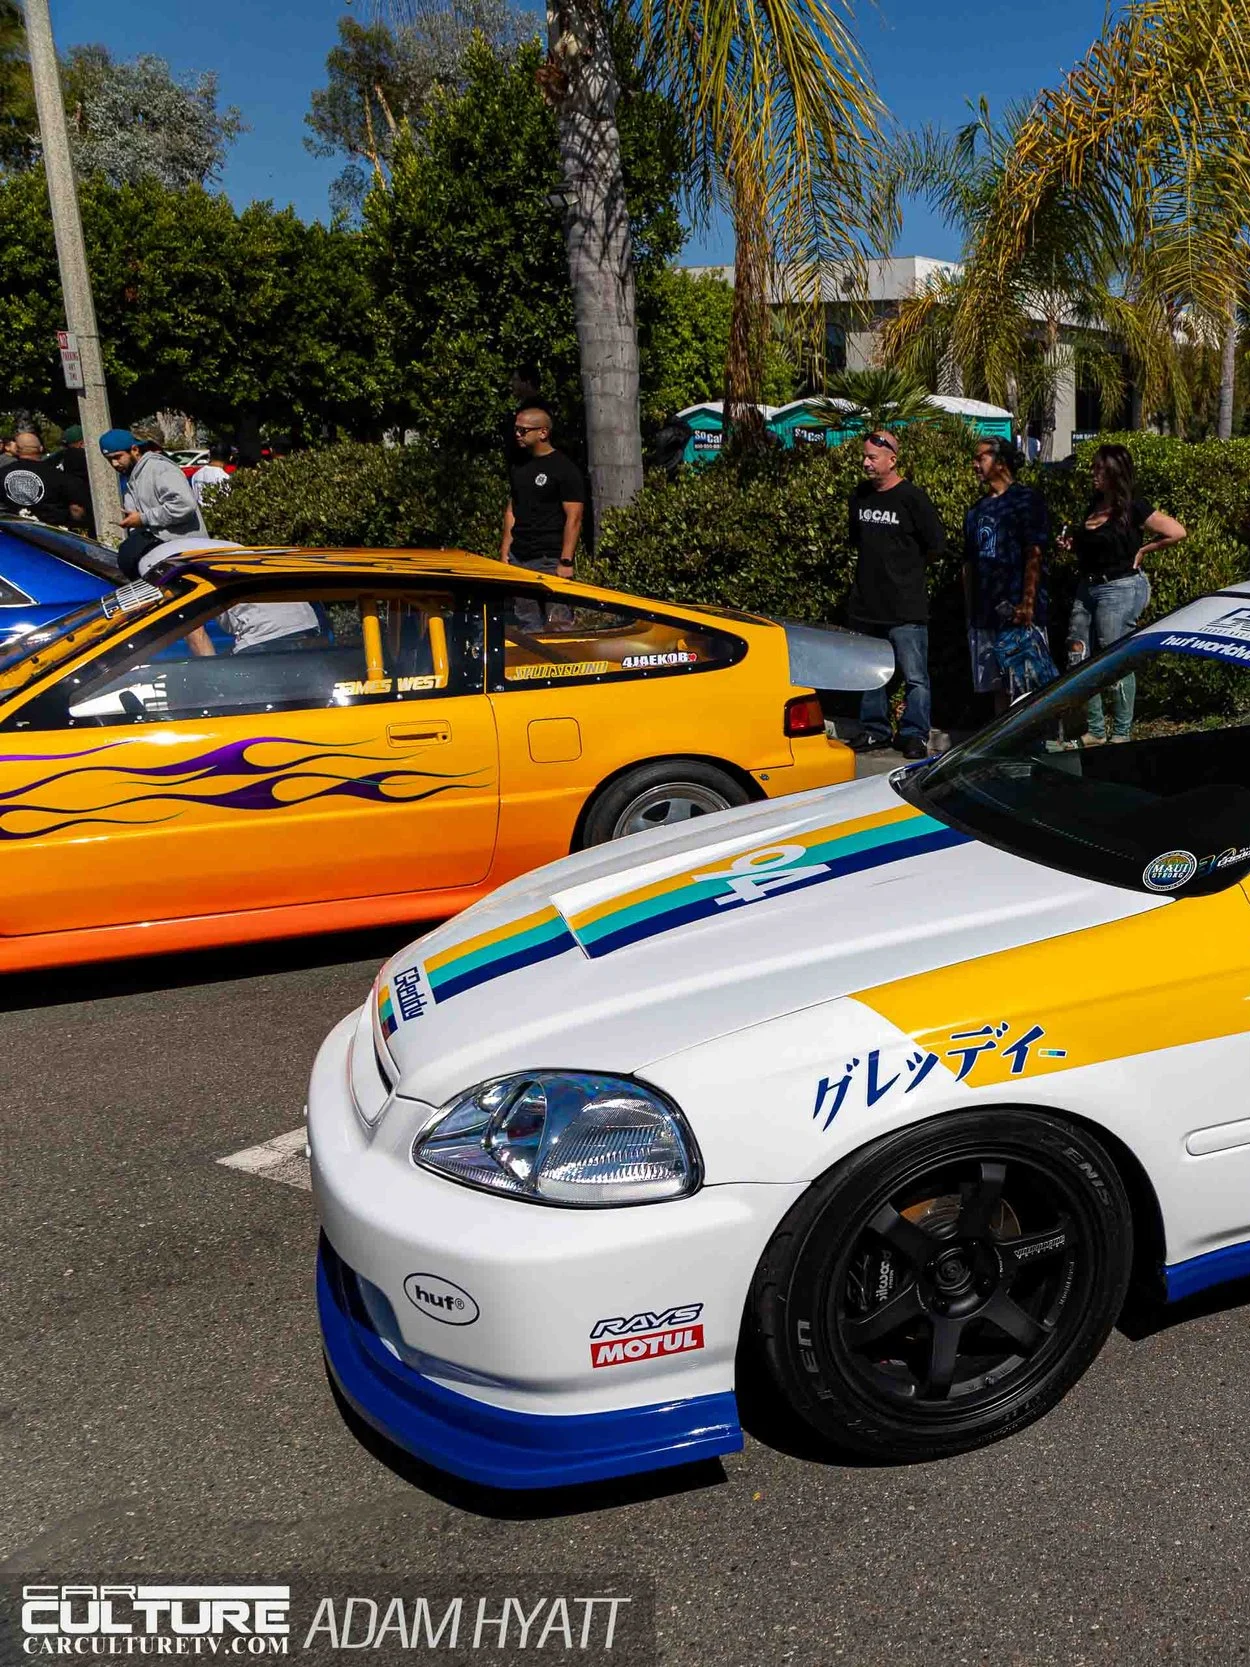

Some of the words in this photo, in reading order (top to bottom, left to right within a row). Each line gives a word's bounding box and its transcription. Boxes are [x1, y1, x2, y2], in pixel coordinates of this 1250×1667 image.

[859, 508, 900, 525] LOCAL
[1160, 634, 1196, 647] huf
[397, 675, 445, 692] WEST
[691, 844, 832, 907] 94
[1151, 871, 1185, 879] STRONG
[1152, 863, 1190, 873] MAUI
[393, 966, 428, 1022] GReddy
[812, 1022, 1067, 1133] グレッディー
[589, 1302, 704, 1339] RAYS
[596, 1329, 698, 1365] MOTUL
